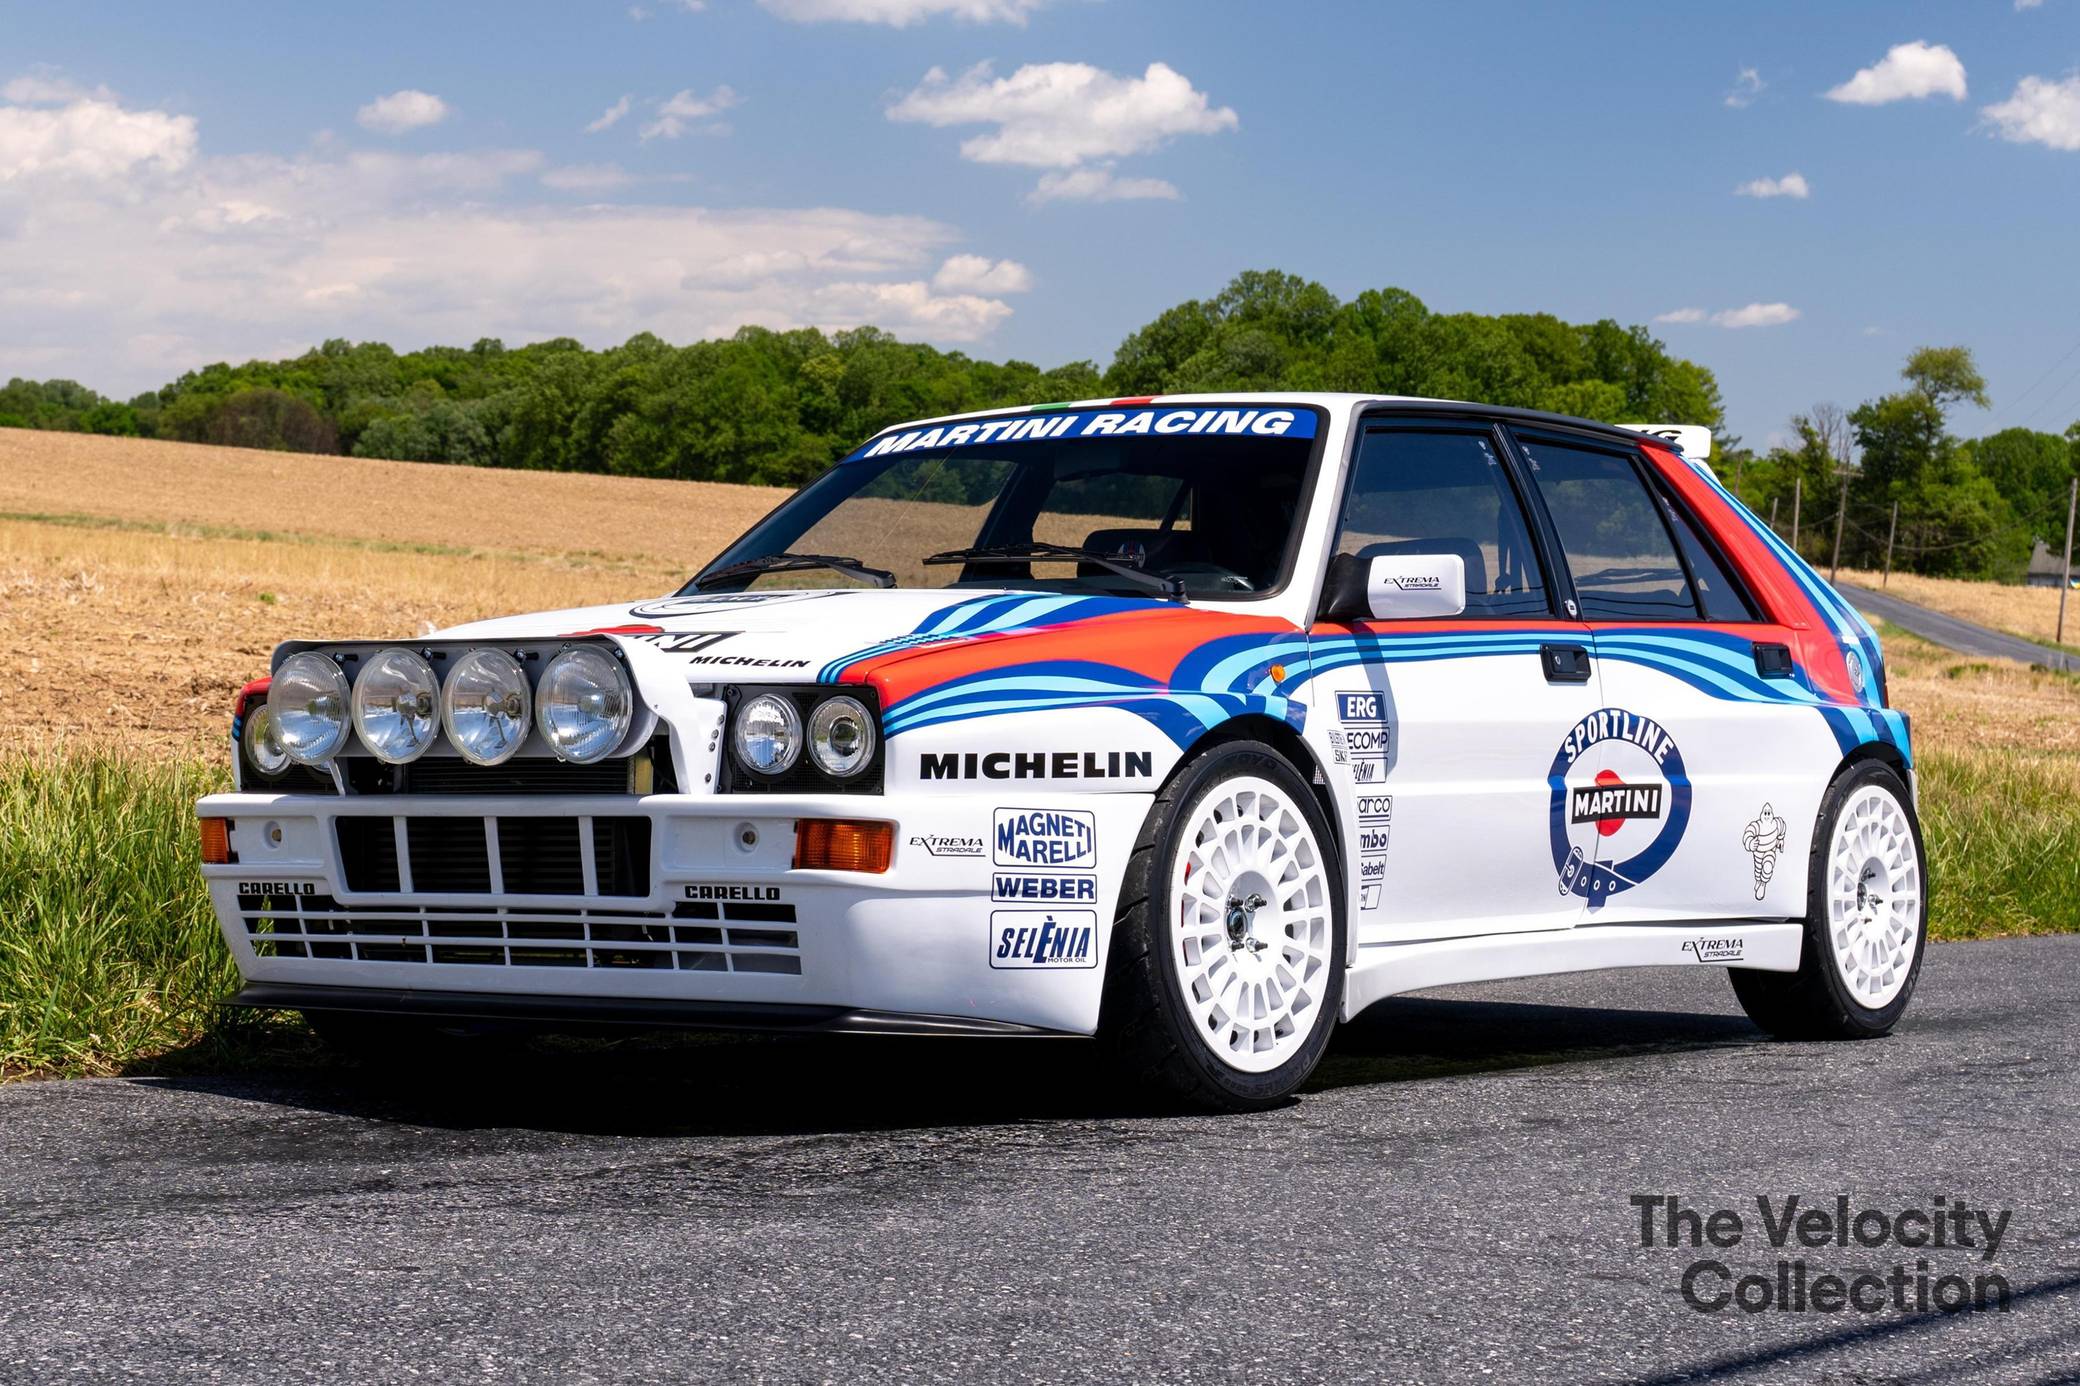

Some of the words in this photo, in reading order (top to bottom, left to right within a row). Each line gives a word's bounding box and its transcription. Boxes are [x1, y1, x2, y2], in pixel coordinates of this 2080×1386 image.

[863, 415, 1077, 458] MARTINI
[1082, 409, 1297, 436] RACING
[1384, 575, 1440, 585] EXTREMA
[688, 655, 812, 668] MICHELIN
[1346, 696, 1377, 718] ERG
[1564, 709, 1676, 766] SPORTLINE
[920, 751, 1153, 780] MICHELIN
[1358, 797, 1391, 814] arco
[1574, 789, 1659, 817] MARTINI
[998, 812, 1092, 846] MAGNETI
[909, 834, 984, 848] EXTREMA
[935, 846, 983, 854] STRADALE
[998, 830, 1092, 864] MARELLI
[239, 882, 315, 895] CARELLO
[685, 885, 780, 900] CARELLO
[996, 877, 1095, 899] WEBER
[996, 915, 1091, 963] SELÈNIA
[1681, 937, 1743, 952] EXTREMA
